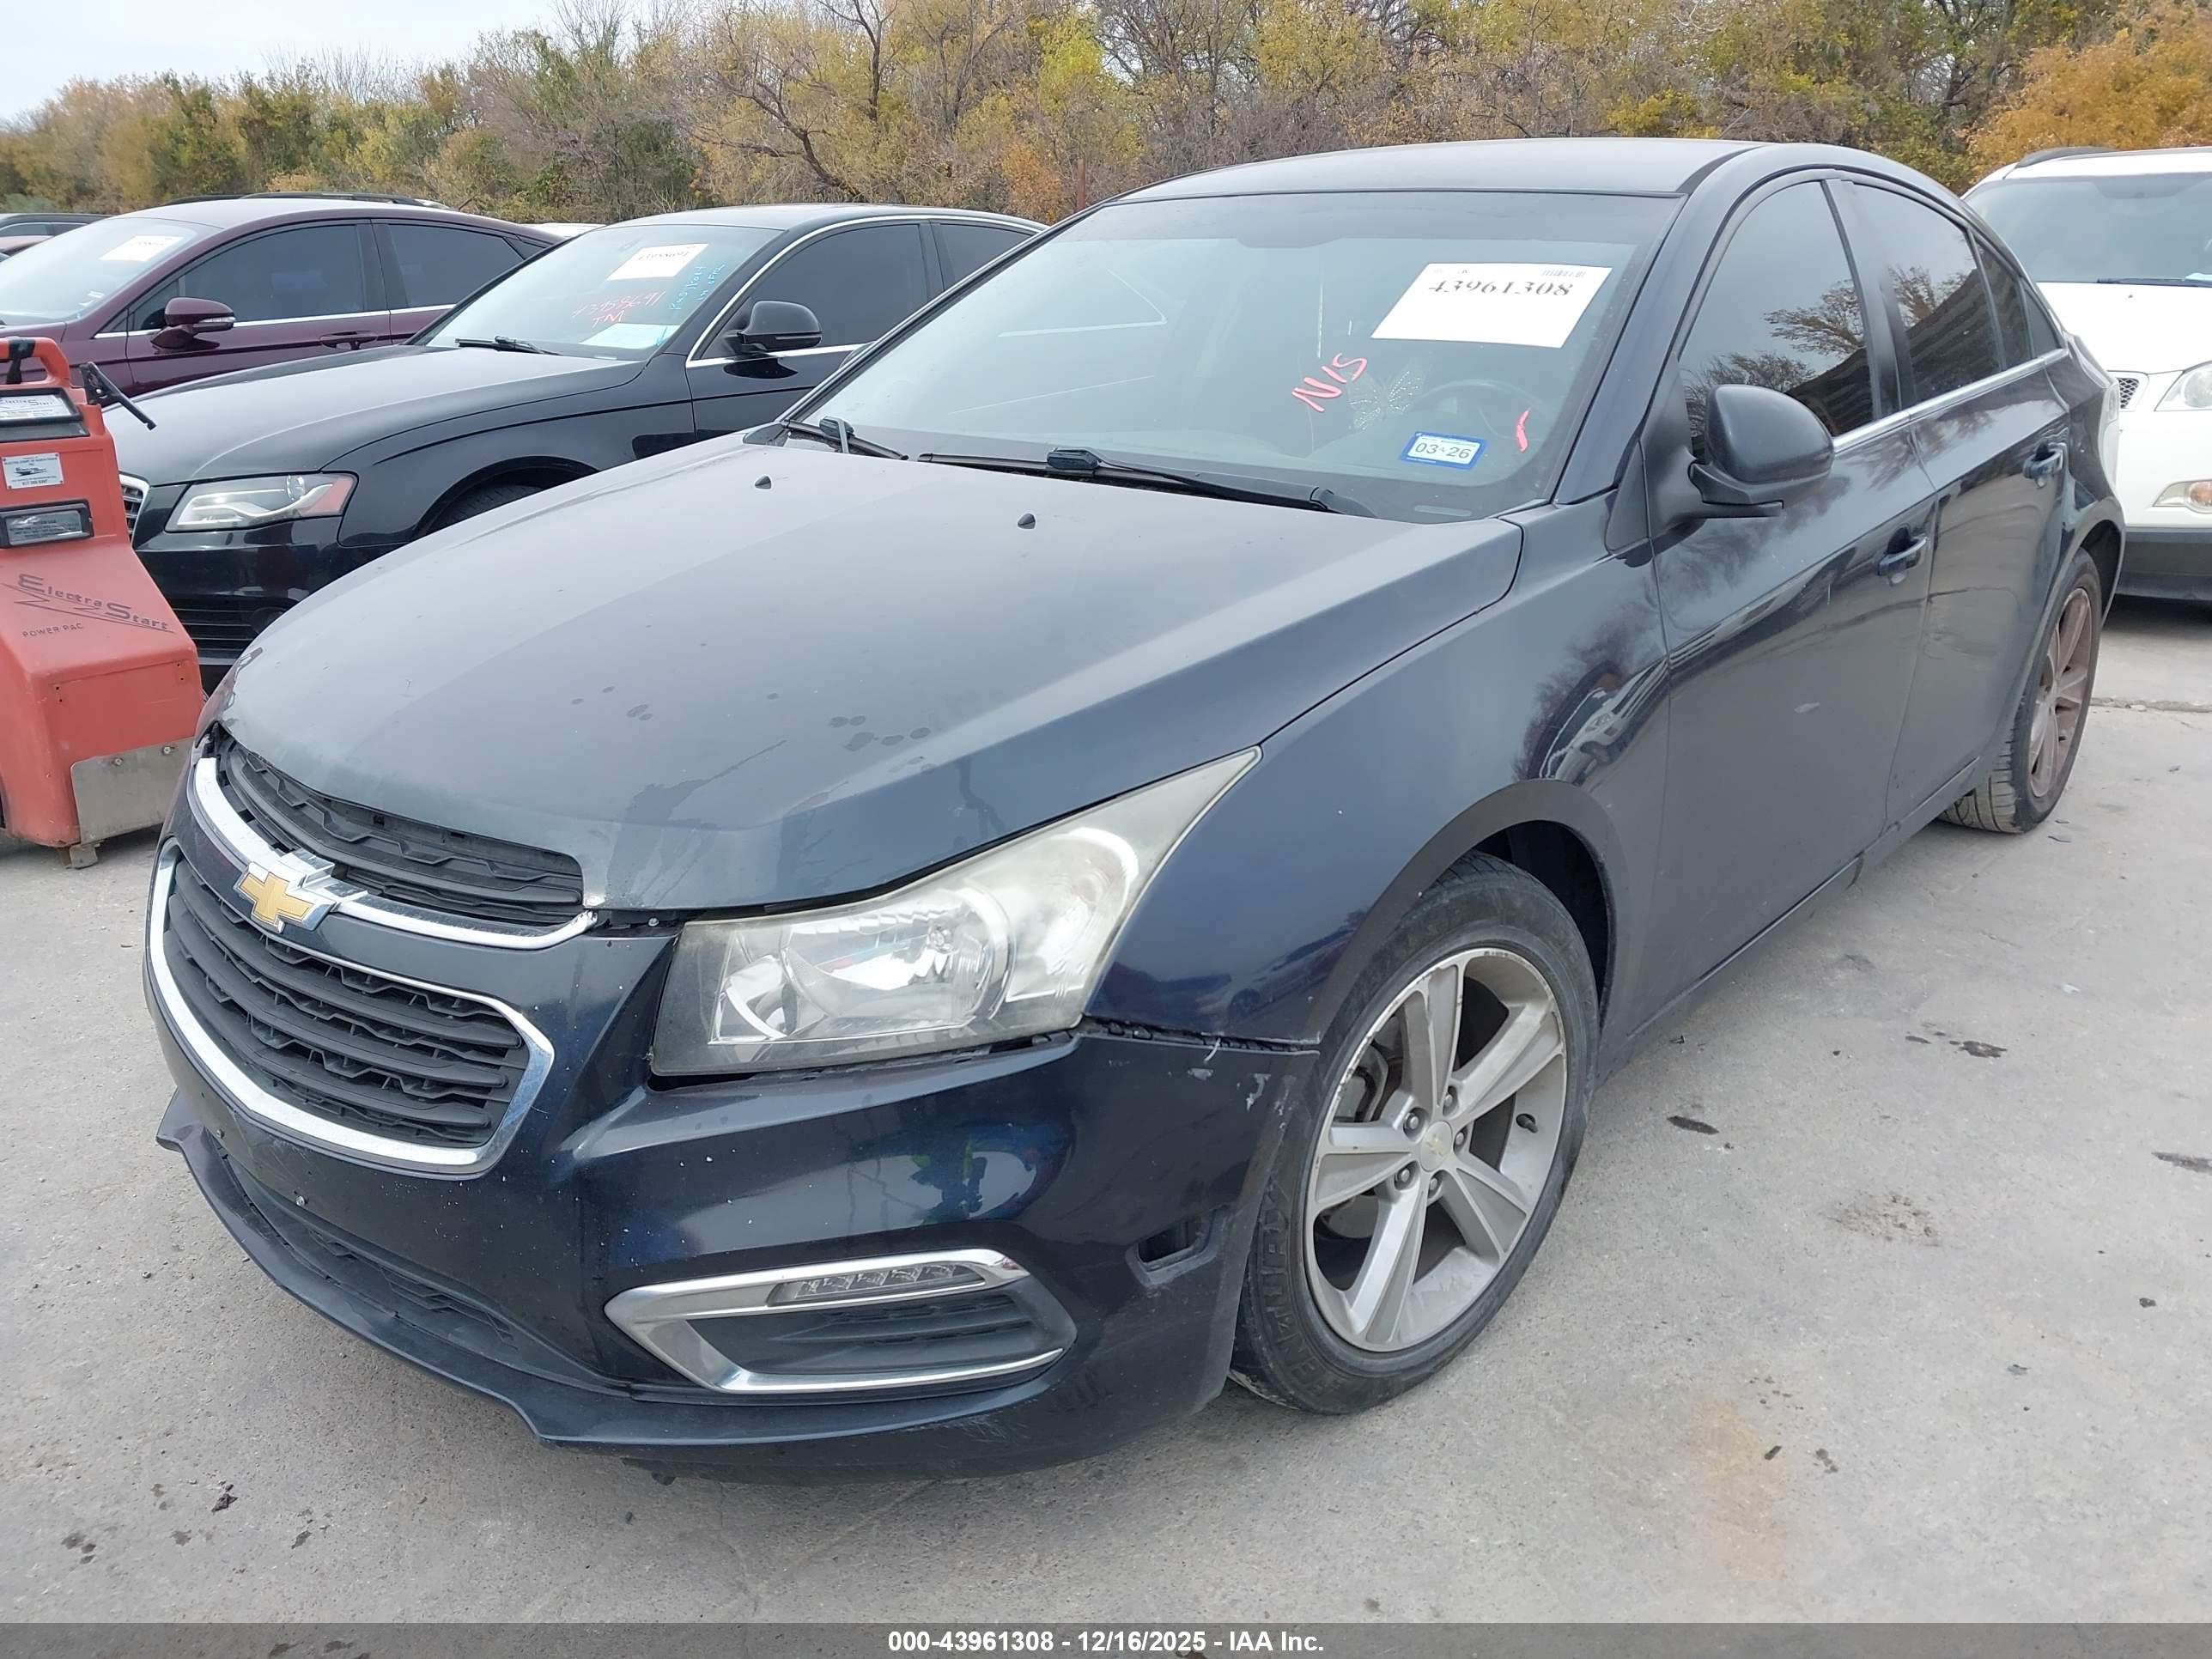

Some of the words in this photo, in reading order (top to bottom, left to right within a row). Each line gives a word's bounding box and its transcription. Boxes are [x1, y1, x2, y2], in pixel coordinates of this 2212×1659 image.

[1428, 279, 1574, 296] 43961308
[1291, 352, 1368, 413] NIS
[22, 626, 60, 638] POWER
